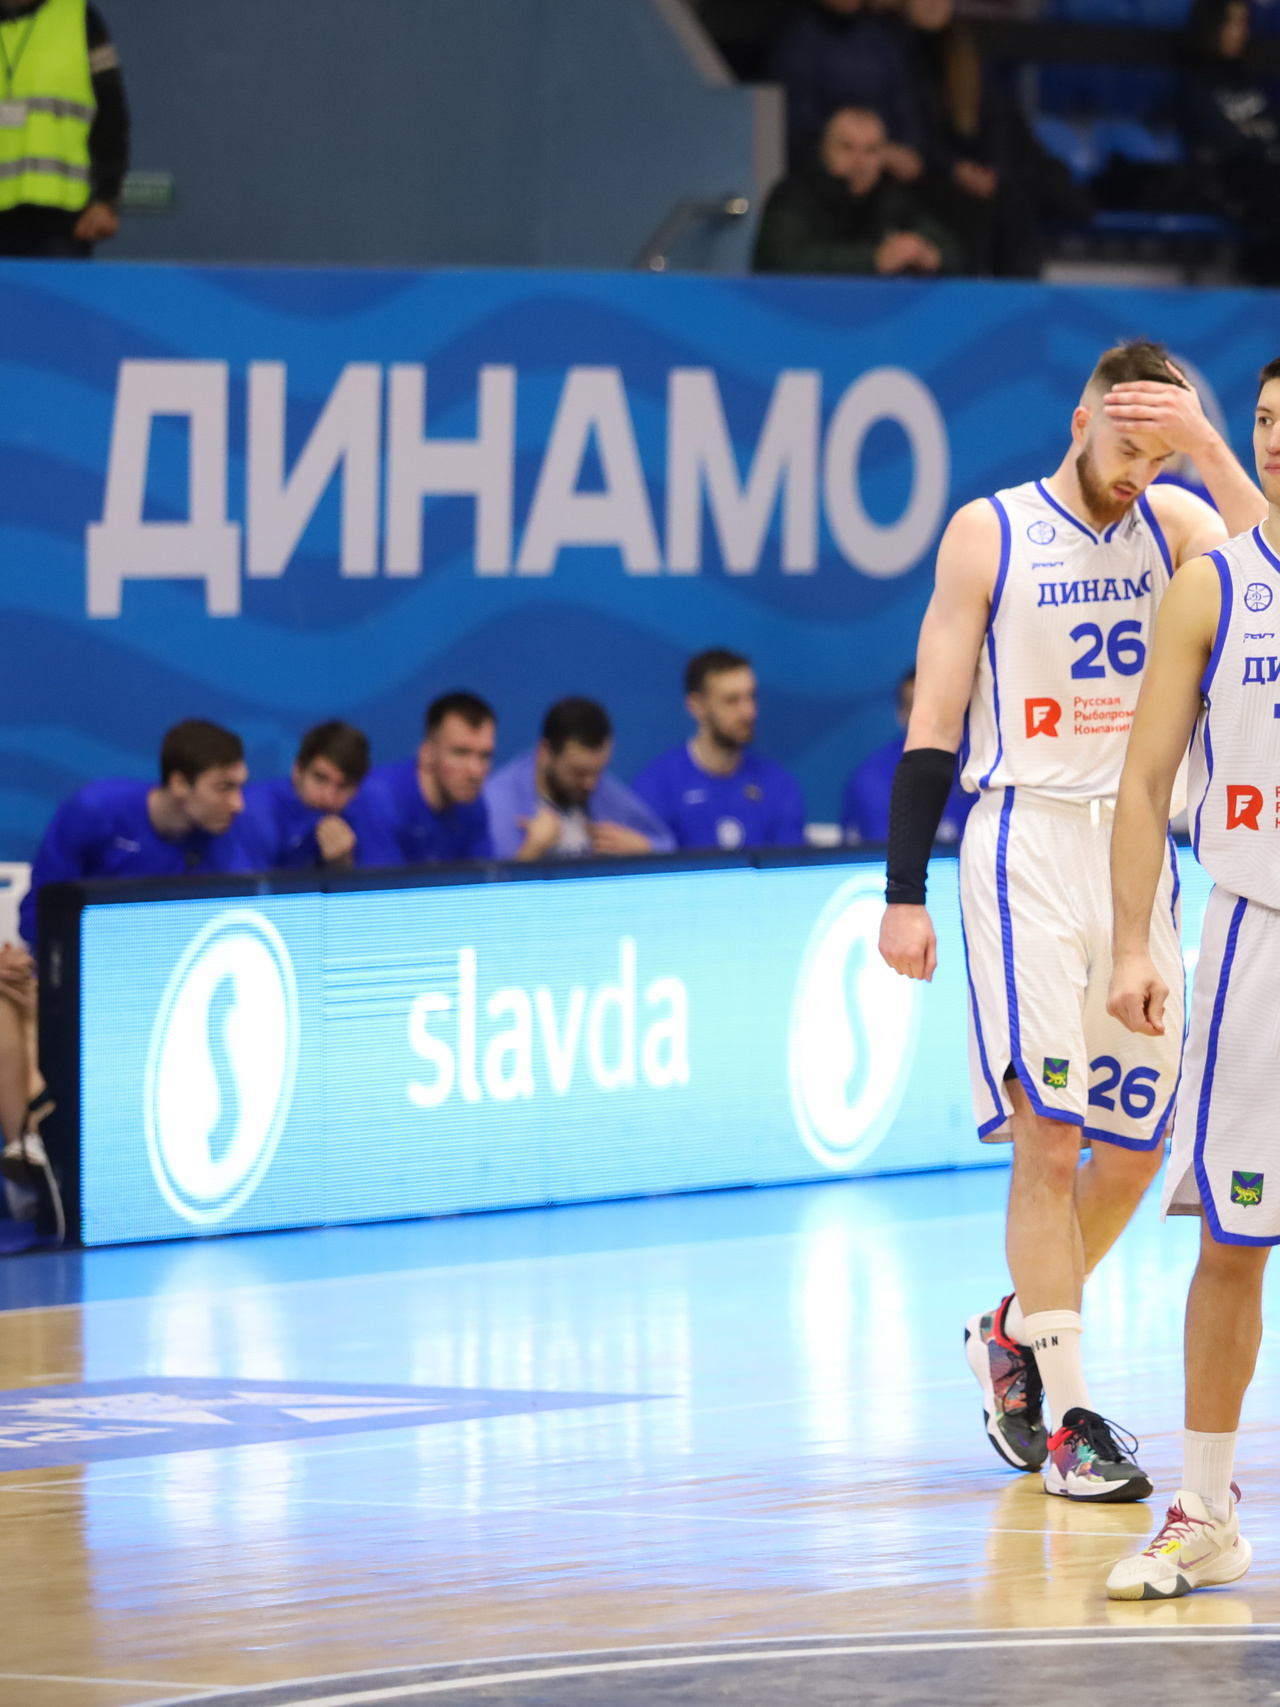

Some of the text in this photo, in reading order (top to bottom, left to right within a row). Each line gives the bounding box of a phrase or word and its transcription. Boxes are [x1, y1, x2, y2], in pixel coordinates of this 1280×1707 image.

[86, 359, 950, 618] ДИНАМО
[1069, 620, 1146, 679] 26
[1074, 696, 1121, 709] Русская
[406, 935, 690, 1108] slavda
[1087, 1055, 1161, 1119] 26
